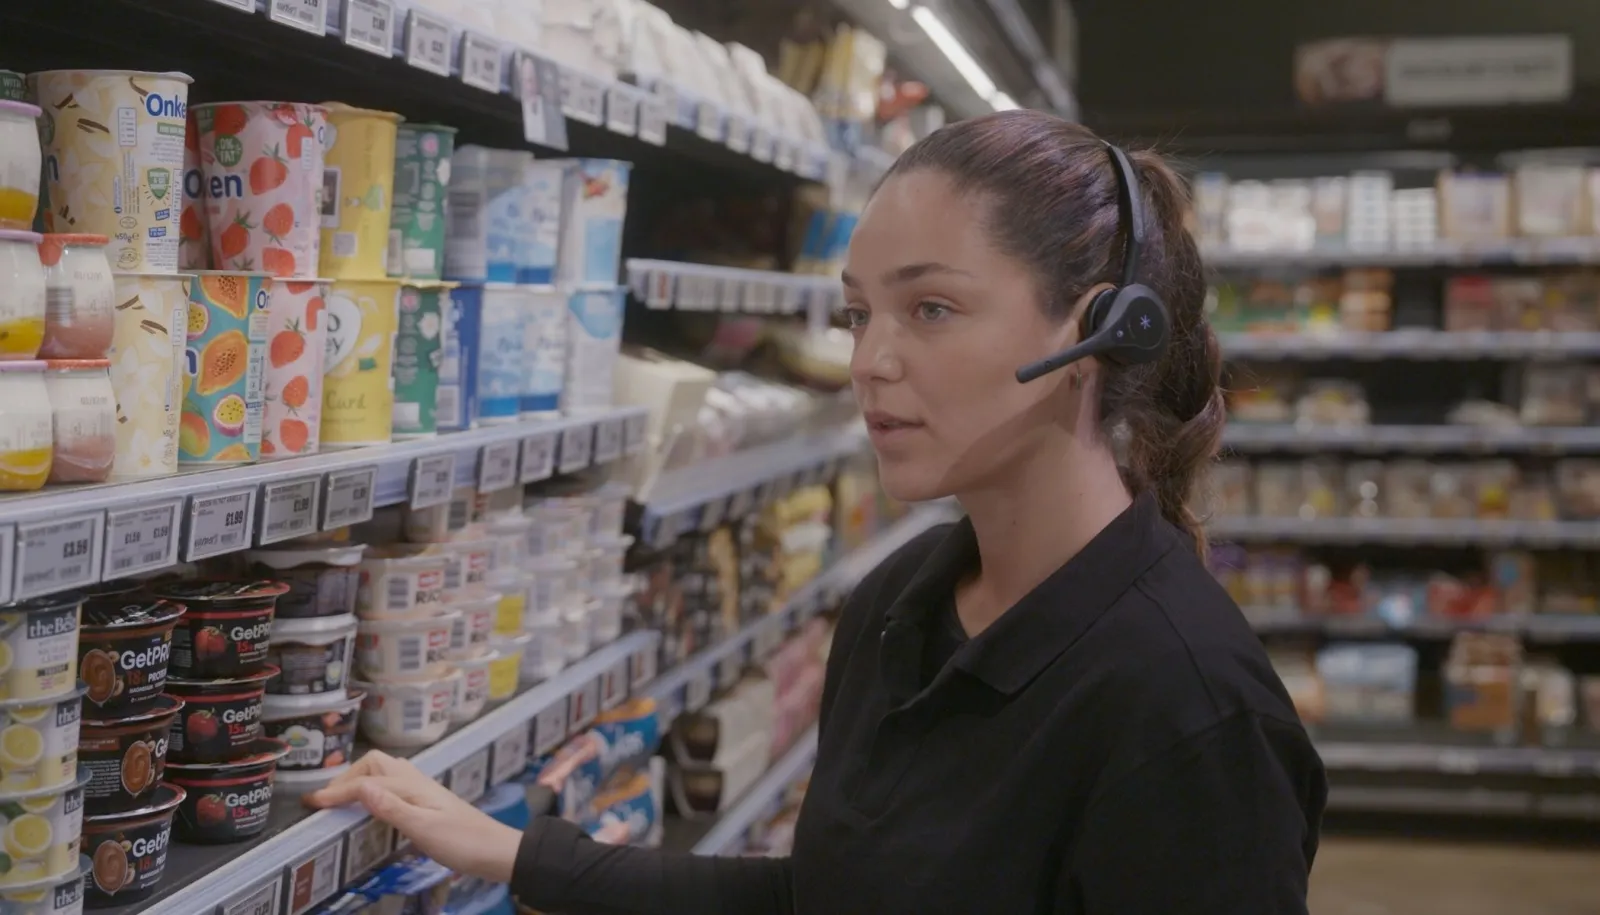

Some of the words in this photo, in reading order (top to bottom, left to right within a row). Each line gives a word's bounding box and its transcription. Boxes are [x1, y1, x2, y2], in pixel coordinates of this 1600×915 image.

[220, 150, 235, 163] FAT
[225, 510, 244, 527] £1.99
[30, 619, 54, 638] the
